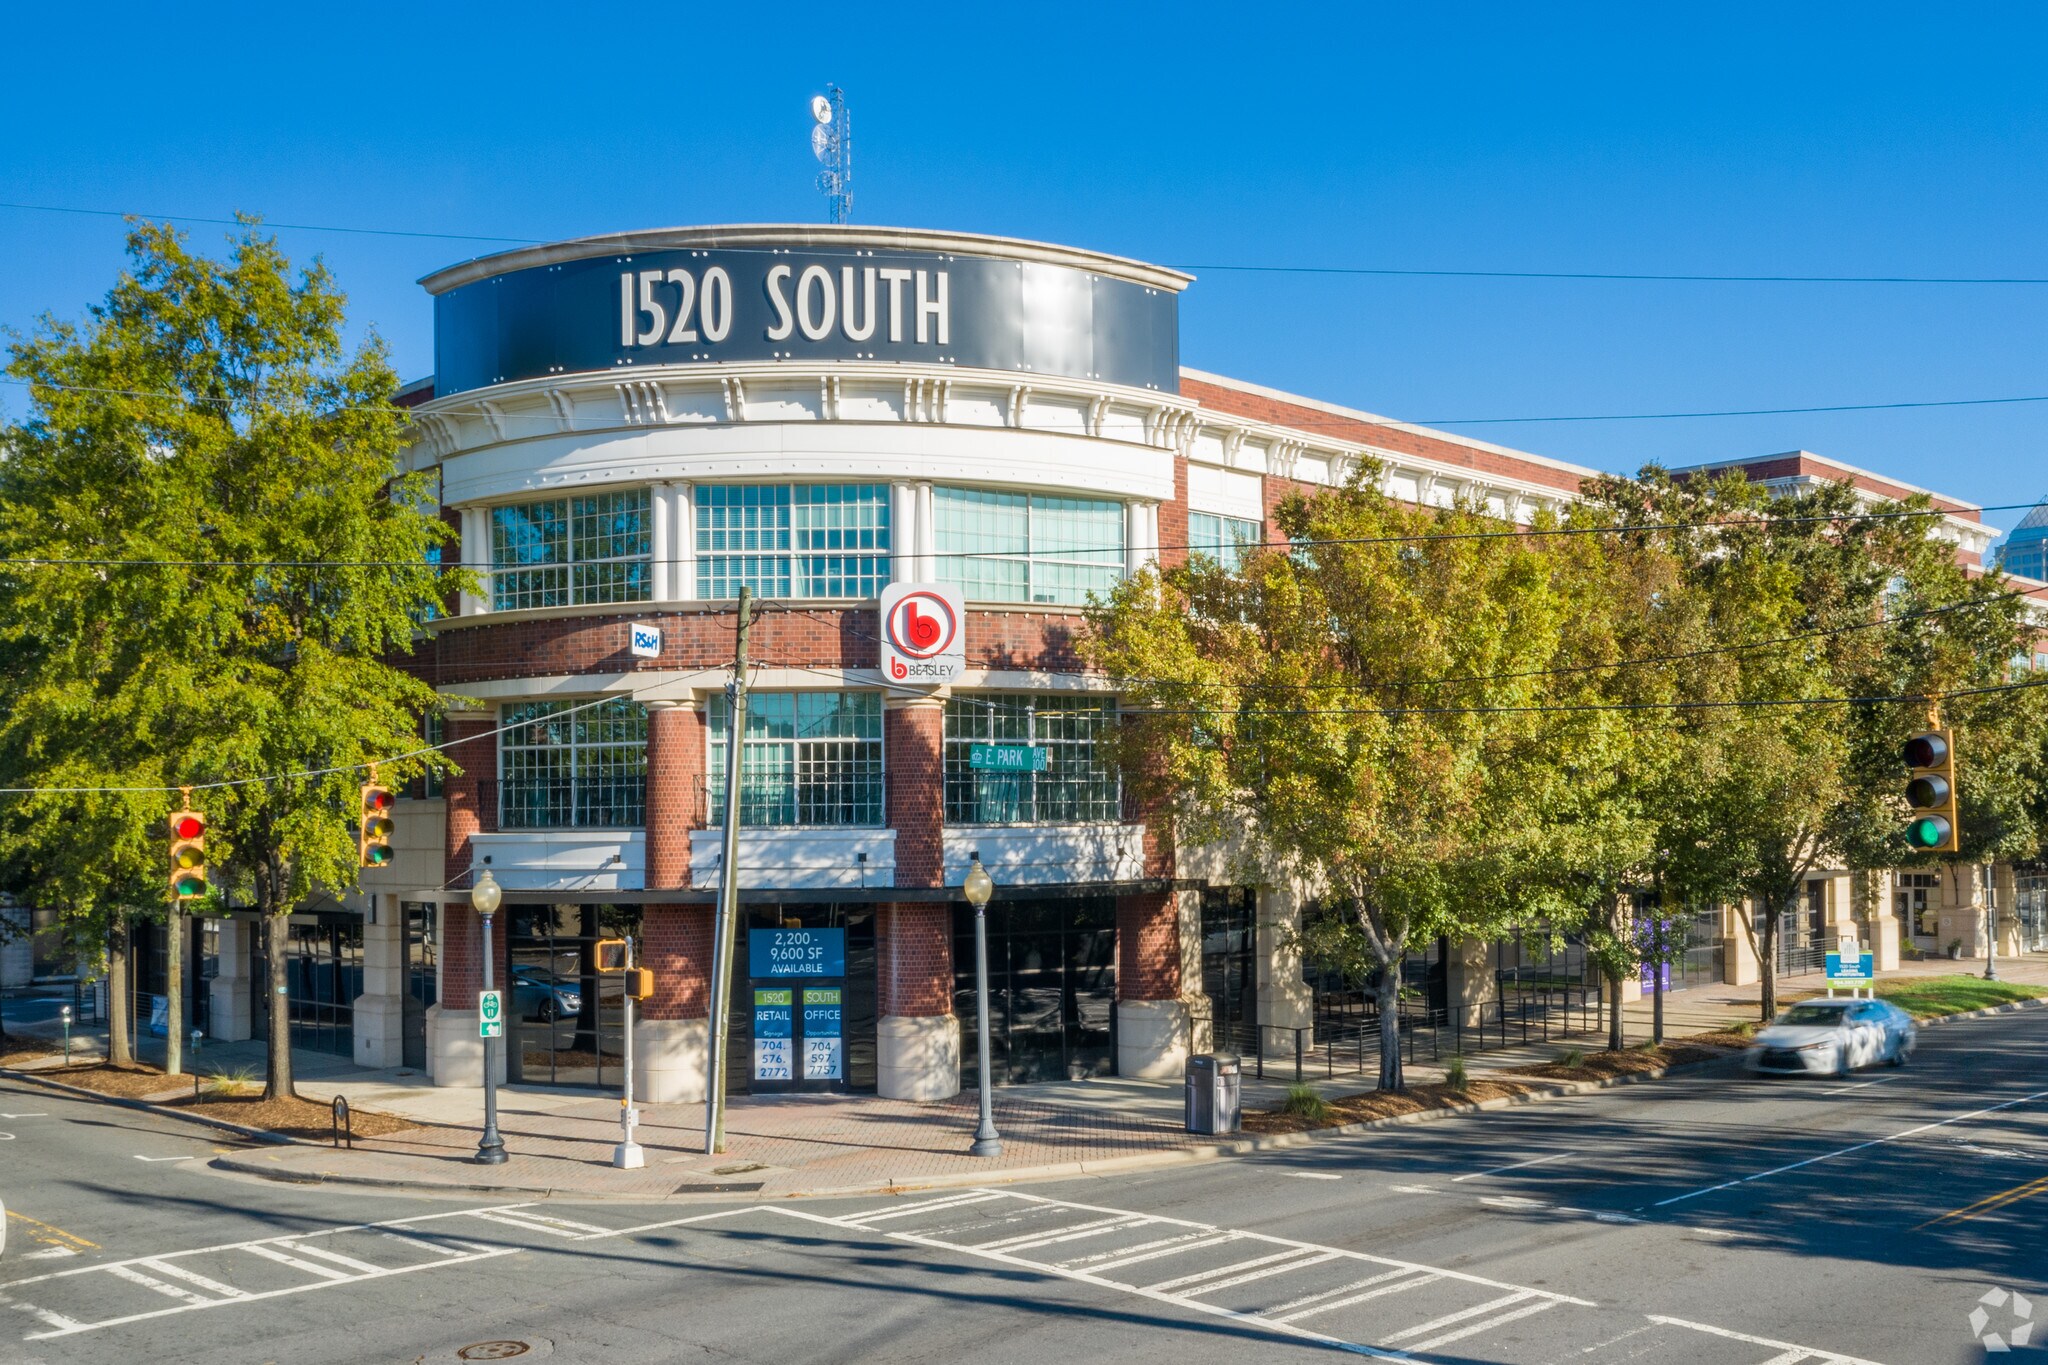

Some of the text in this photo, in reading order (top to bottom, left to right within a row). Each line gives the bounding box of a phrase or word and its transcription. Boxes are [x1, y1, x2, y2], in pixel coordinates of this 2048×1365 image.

[621, 264, 949, 347] 1520 SOUTH
[909, 664, 954, 676] BEASLEY
[985, 748, 1024, 766] E. PARK
[1032, 747, 1046, 759] AVE
[1032, 759, 1045, 771] 100
[775, 932, 810, 947] 2,200
[770, 947, 823, 962] 9,600 SF
[770, 963, 823, 974] AVAILABLE
[763, 992, 784, 1003] 1520
[806, 992, 838, 1002] SOUTH
[756, 1010, 791, 1021] RETAIL
[804, 1010, 841, 1020] OFFICE
[762, 1041, 786, 1050] 704.
[811, 1042, 835, 1052] 704.
[762, 1054, 786, 1064] 576.
[811, 1054, 835, 1063] 597.
[760, 1067, 788, 1077] 2772
[809, 1066, 837, 1075] 7757
